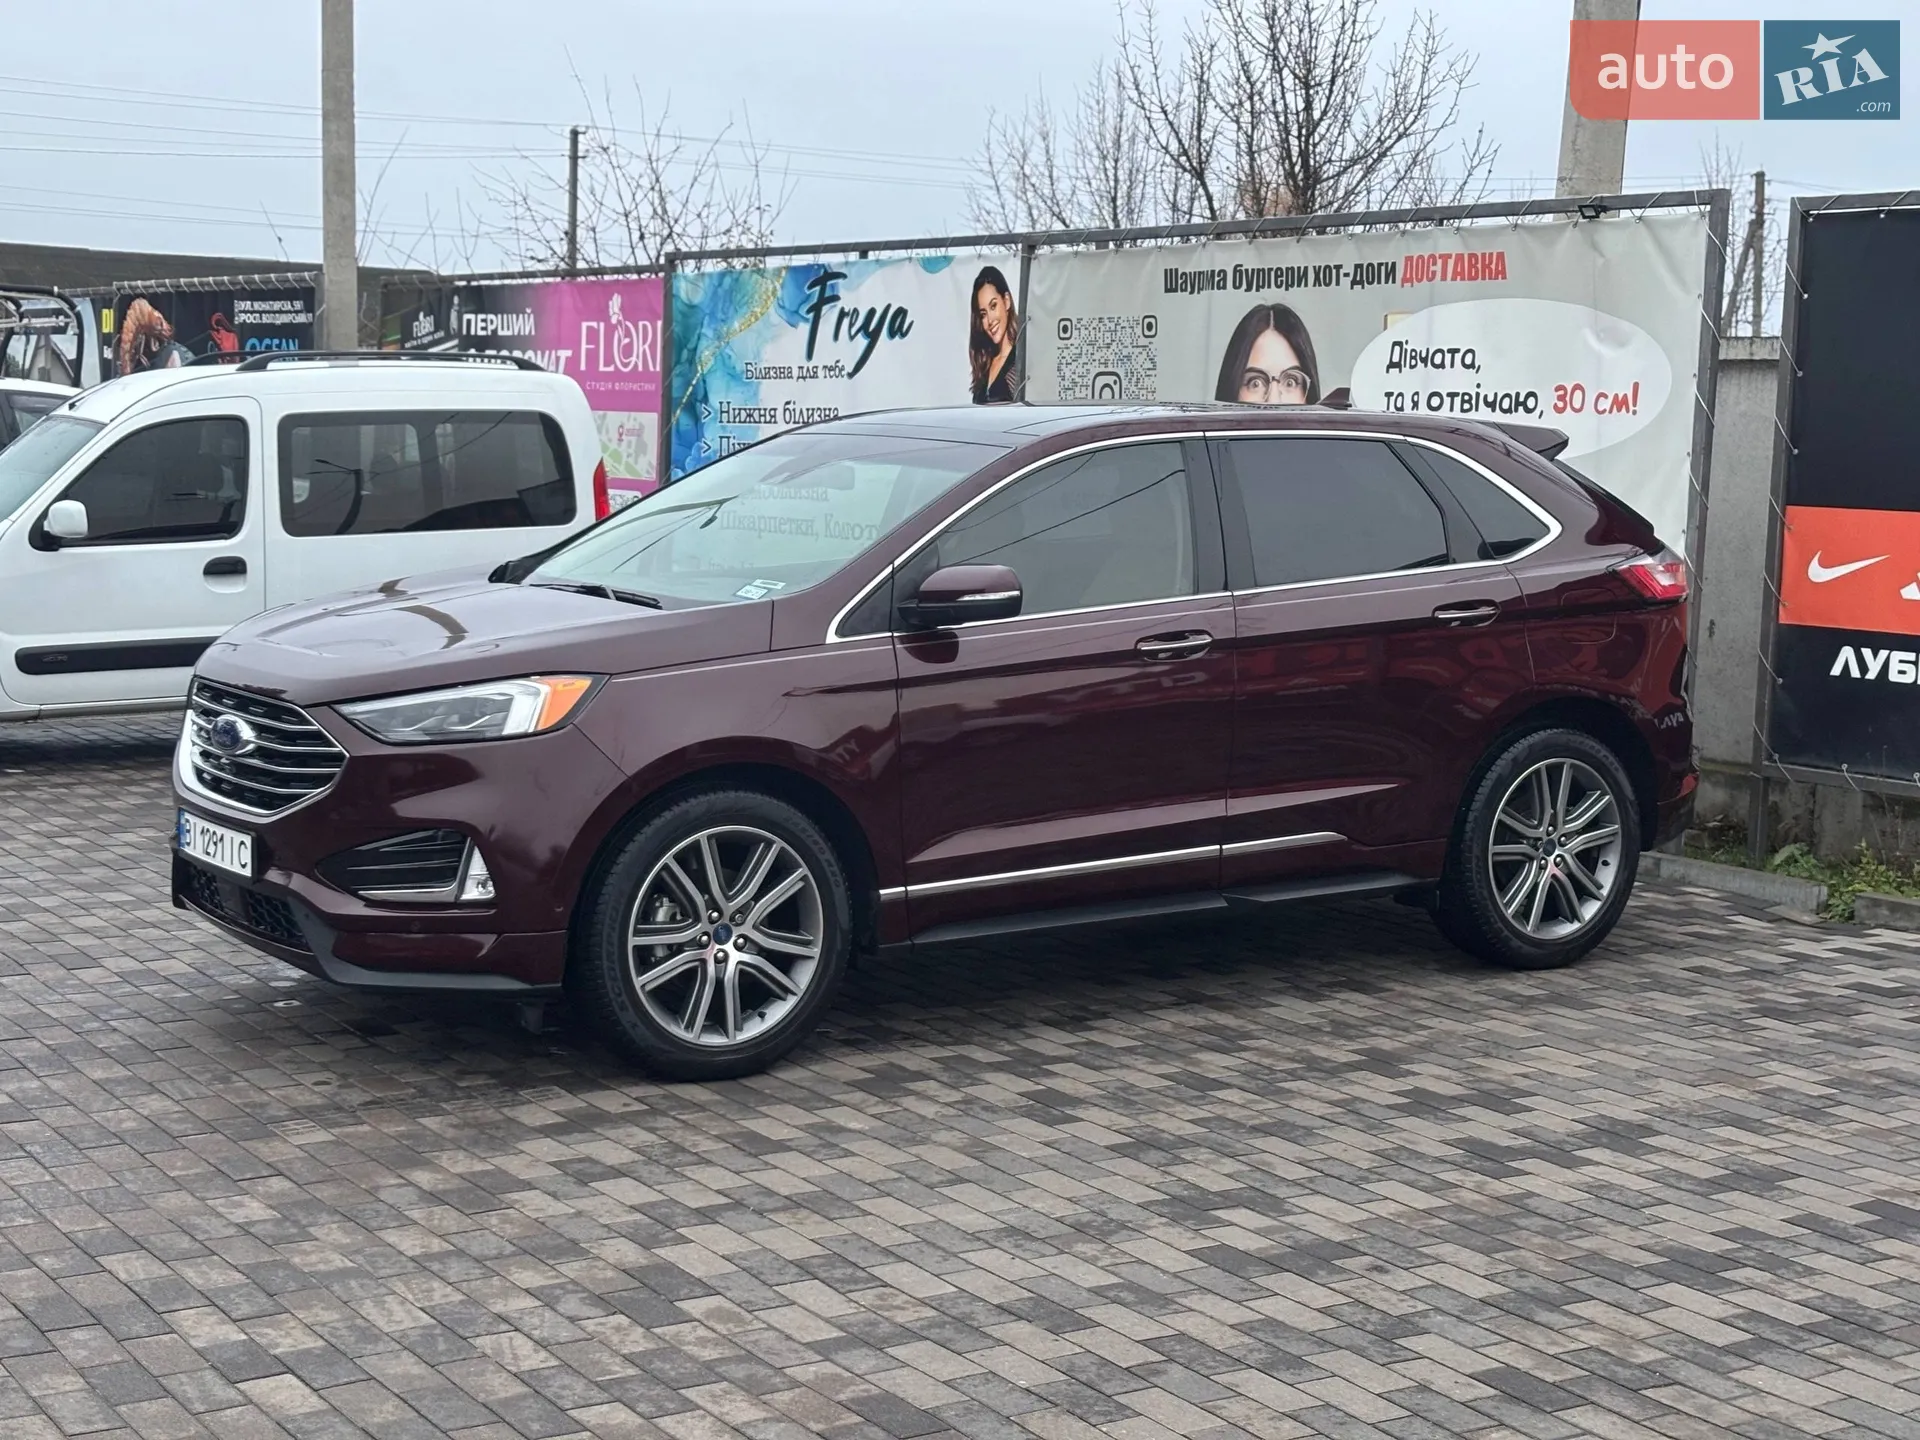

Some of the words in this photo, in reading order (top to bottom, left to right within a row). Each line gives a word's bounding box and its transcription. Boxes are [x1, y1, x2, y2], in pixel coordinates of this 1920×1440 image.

[1163, 267, 1228, 295] Шаурма
[1232, 263, 1309, 293] бургери
[1311, 261, 1398, 291] хот-доги
[1400, 251, 1508, 289] ДОСТАВКА
[461, 307, 536, 336] ПЕРШИЙ
[805, 266, 915, 380] Freya
[579, 320, 662, 373] FLORI
[1385, 339, 1482, 374] Дівчата,
[744, 361, 794, 380] Білизна
[796, 364, 820, 383] для
[822, 358, 847, 379] тебе
[718, 400, 779, 425] Нижня
[782, 399, 840, 425] білизна
[1384, 390, 1406, 413] та
[1410, 390, 1420, 412] я
[1425, 382, 1545, 420] отвічаю,
[1552, 382, 1587, 415] 30
[1593, 381, 1640, 416] см!
[1829, 645, 1920, 686] ЛУБ
[200, 825, 225, 862] 1291
[230, 836, 249, 869] IC
